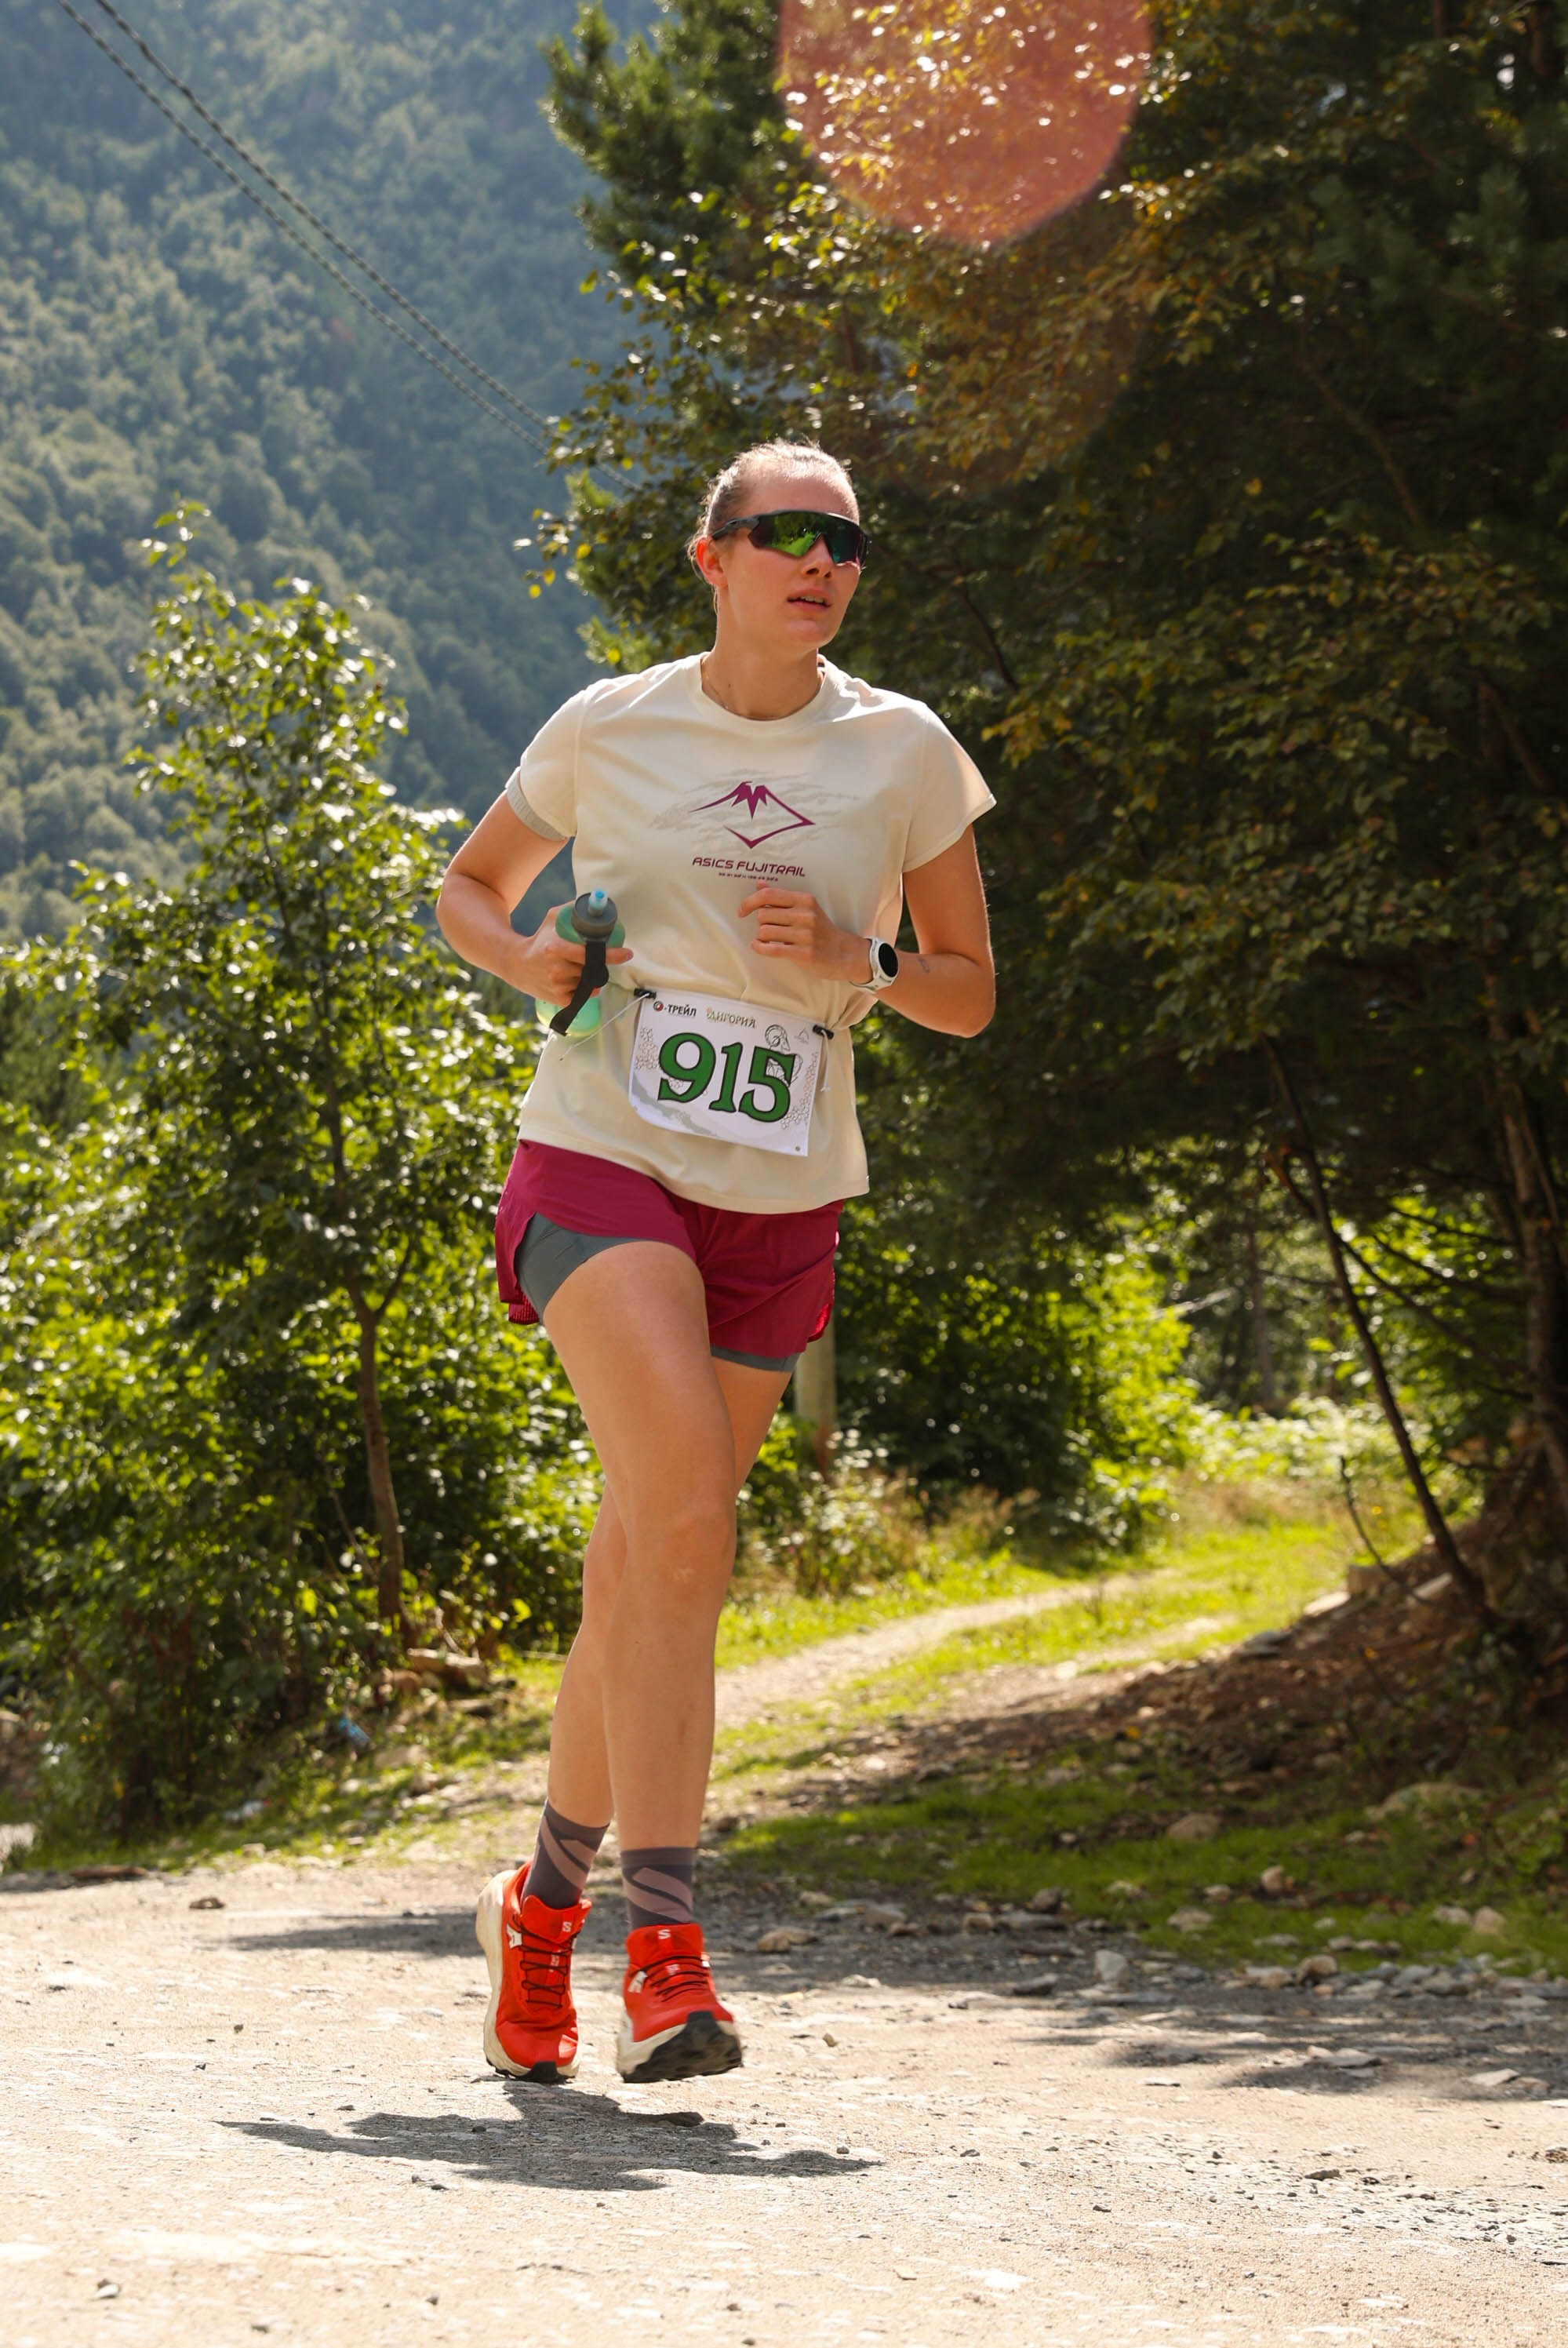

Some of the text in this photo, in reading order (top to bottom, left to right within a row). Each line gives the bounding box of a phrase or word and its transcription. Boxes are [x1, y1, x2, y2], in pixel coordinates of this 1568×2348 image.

[692, 857, 734, 869] ASICS
[736, 861, 806, 877] FUJITRAIL
[657, 1032, 797, 1123] 915
[562, 1921, 572, 1932] S
[657, 1929, 671, 1939] S
